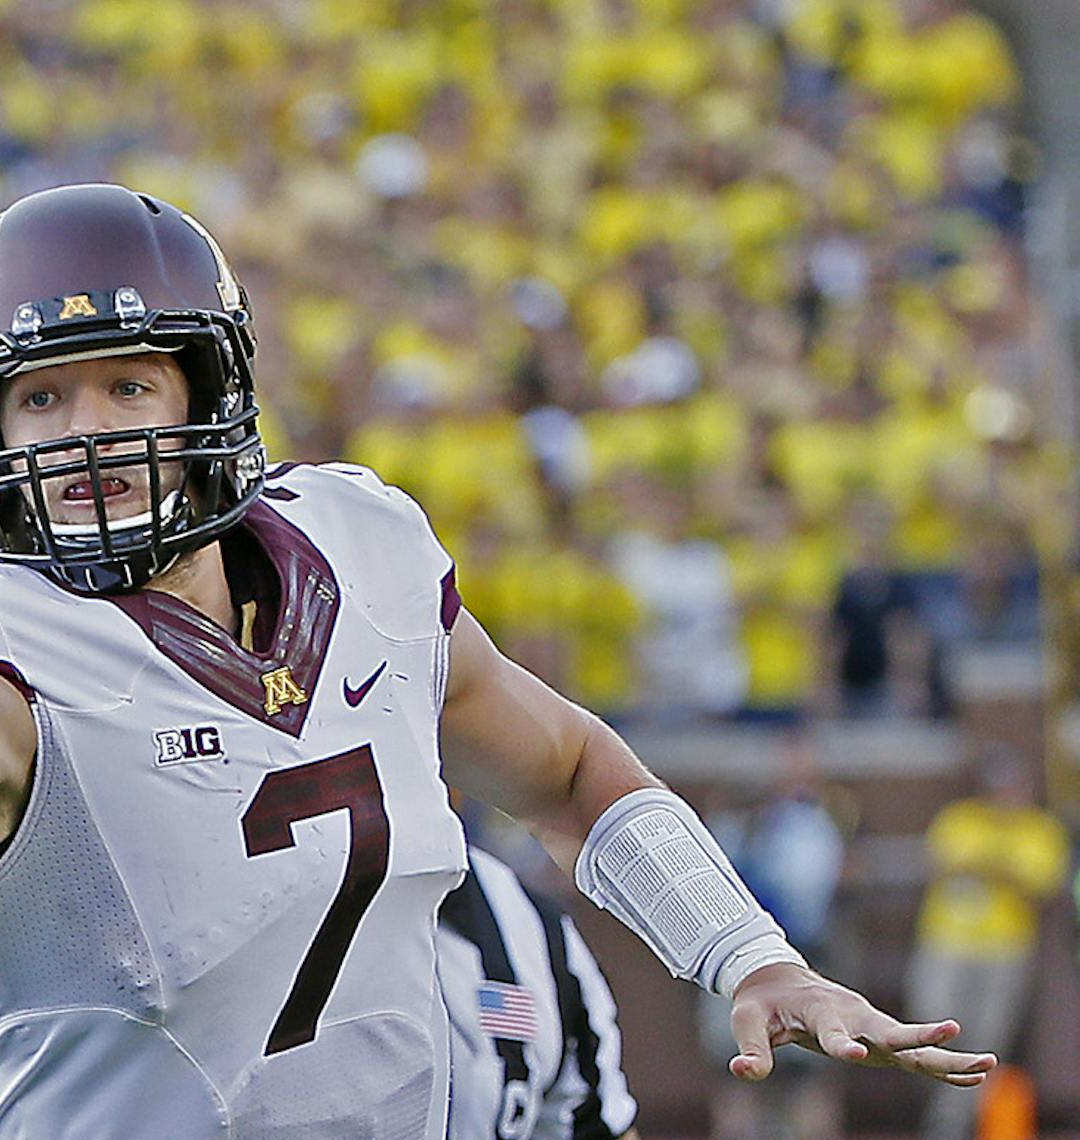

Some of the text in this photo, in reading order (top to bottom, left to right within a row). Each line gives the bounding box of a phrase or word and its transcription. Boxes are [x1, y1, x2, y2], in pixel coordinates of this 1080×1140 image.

[58, 294, 99, 320] M
[259, 666, 308, 716] M
[240, 743, 390, 1056] 7
